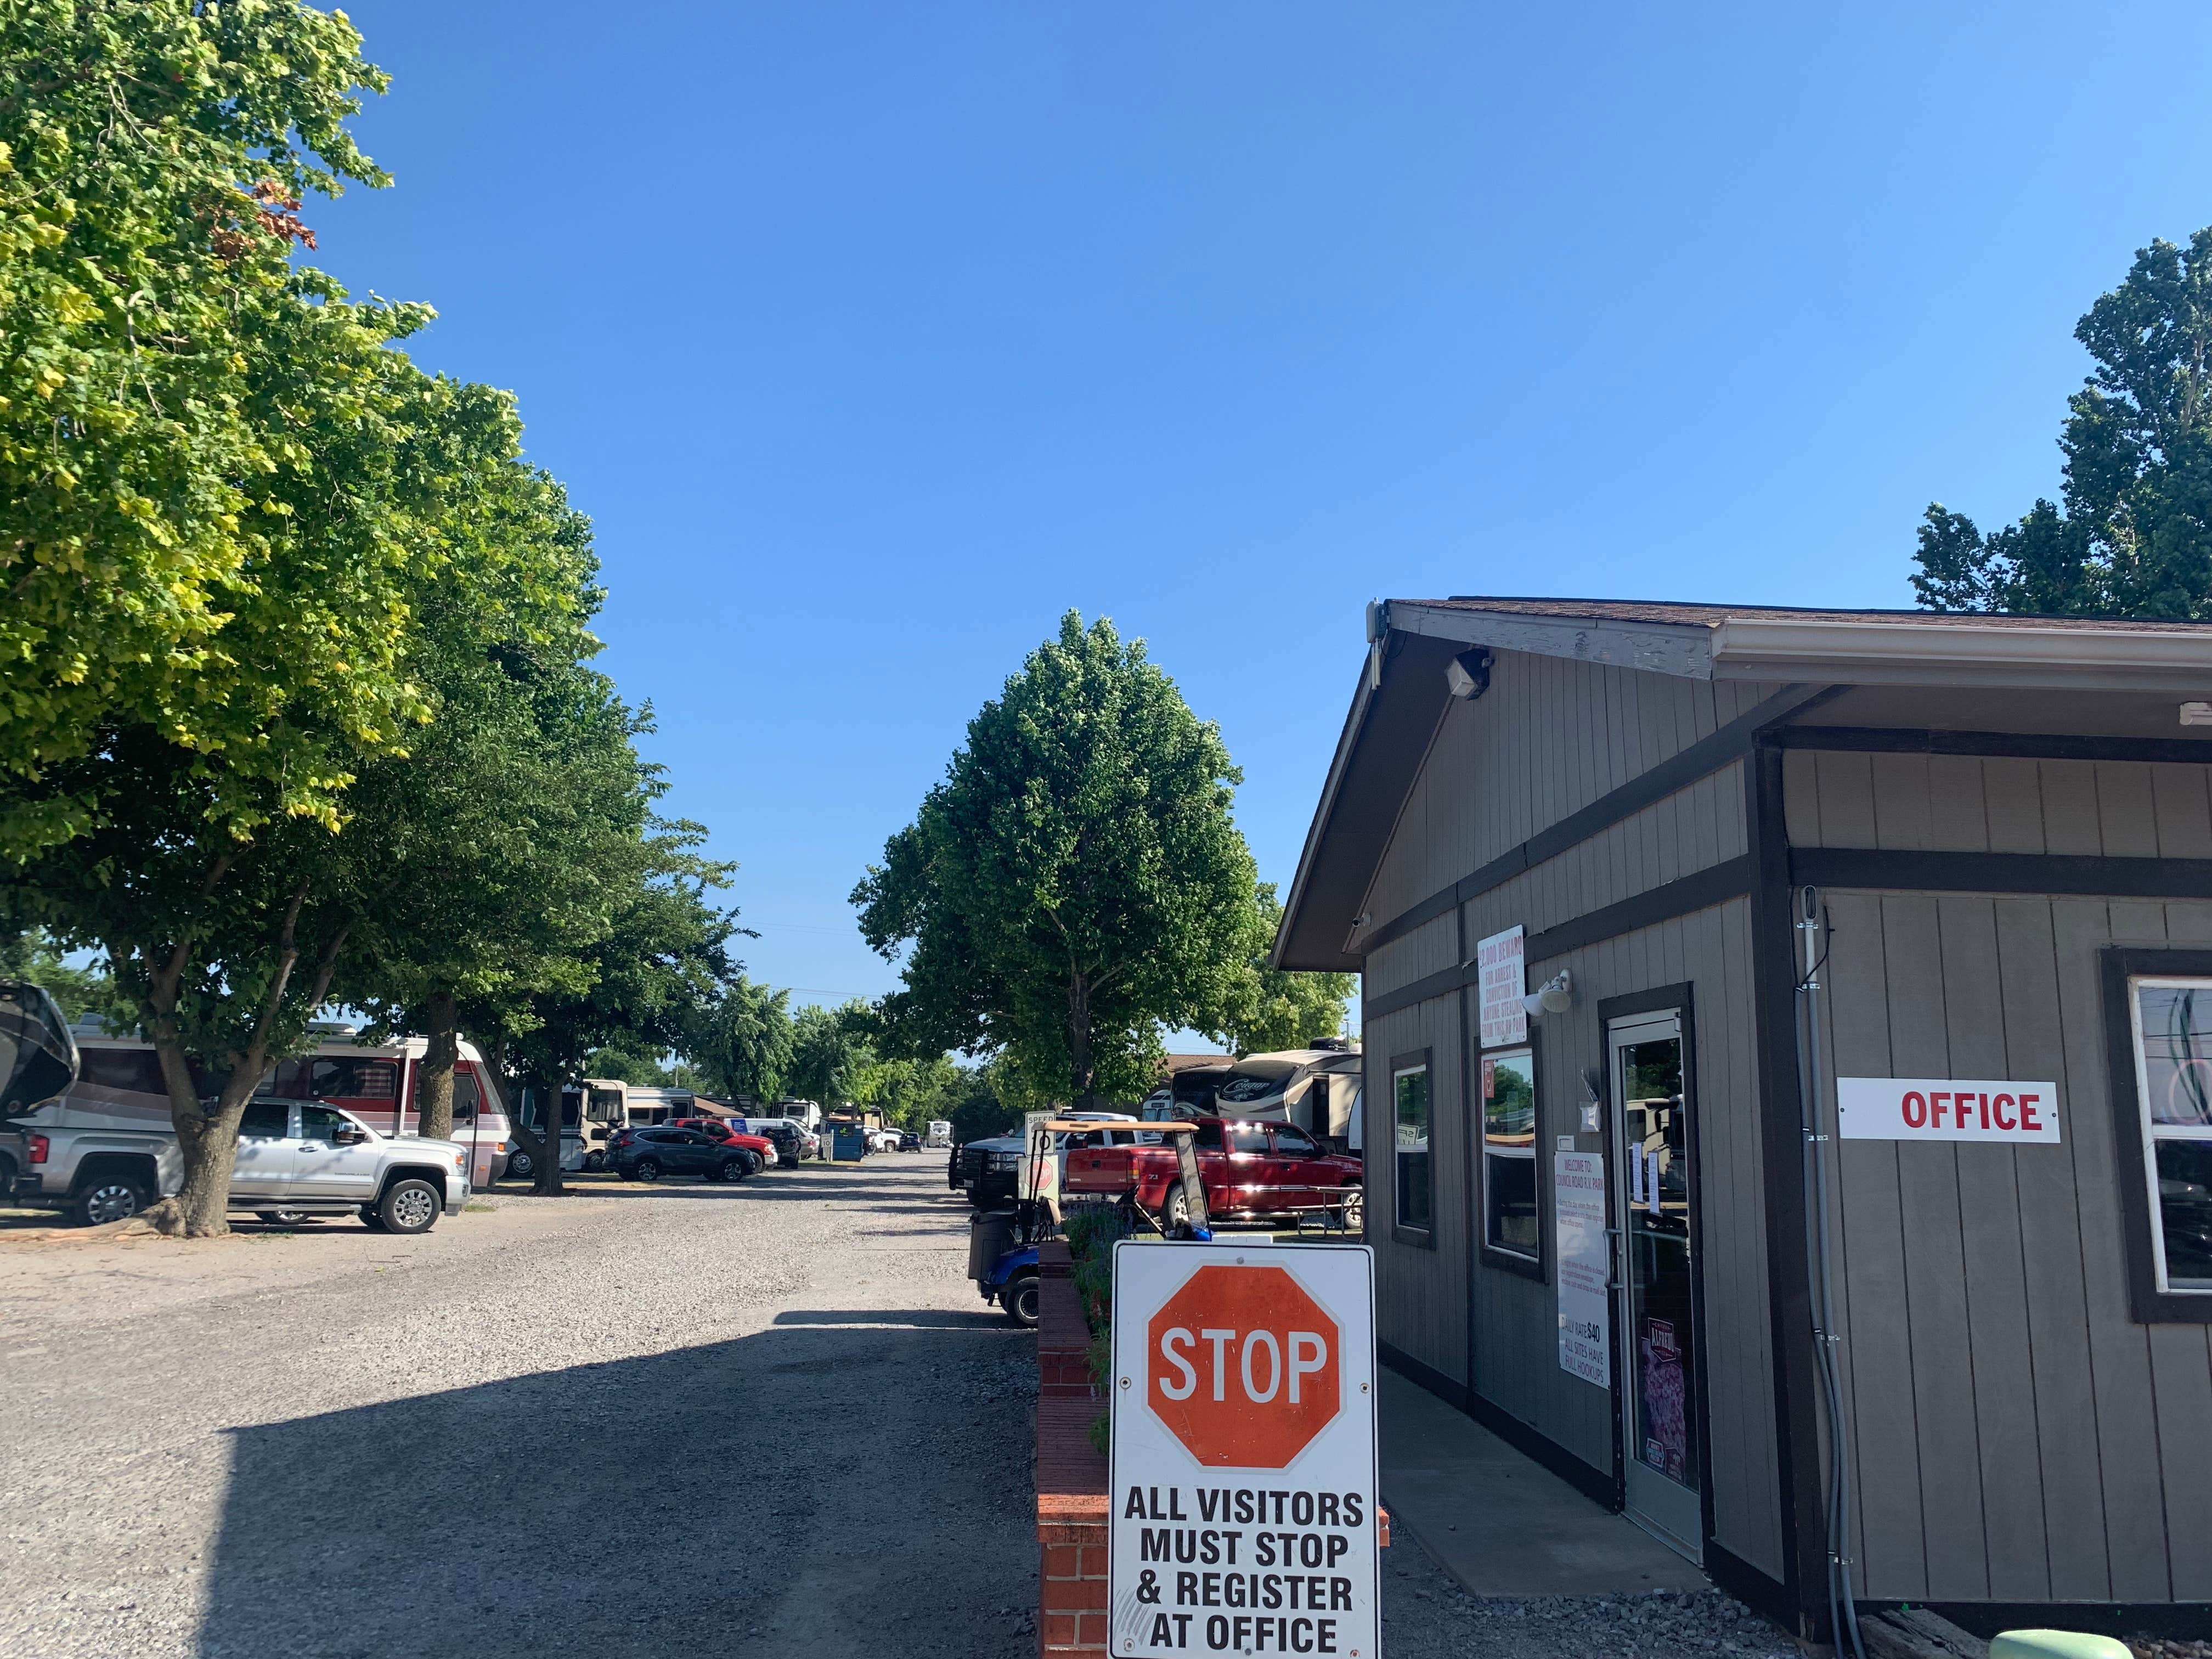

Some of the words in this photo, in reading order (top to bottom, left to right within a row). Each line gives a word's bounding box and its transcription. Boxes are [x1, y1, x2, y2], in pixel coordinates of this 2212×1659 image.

[1499, 935, 1522, 962] REWARD
[1496, 964, 1511, 983] ARREST
[1486, 983, 1511, 1003] CONVICTION
[1513, 981, 1517, 997] OF
[1483, 1003, 1500, 1021] ANYONE
[1501, 998, 1522, 1018] STEALING
[1482, 1023, 1493, 1039] FROM
[1494, 1020, 1505, 1036] THIS
[1513, 1015, 1526, 1034] PARK
[1222, 1079, 1270, 1096] Cougar
[1901, 1091, 2042, 1131] OFFICE
[1564, 1159, 1584, 1172] WELCOME
[1556, 1174, 1572, 1187] COUNCIL
[1572, 1176, 1584, 1189] ROAD
[1592, 1177, 1604, 1190] PARK
[1562, 1316, 1575, 1334] DAILY
[1565, 1338, 1573, 1353] ALL
[1575, 1342, 1588, 1358] SITES
[1589, 1347, 1603, 1365] HAVE
[1159, 1327, 1328, 1404] STOP
[1566, 1354, 1577, 1371] FULL
[1577, 1361, 1604, 1383] HOOKUPS
[1124, 1486, 1187, 1521] ALL
[1197, 1488, 1363, 1527] VISITORS
[1141, 1528, 1242, 1565] MUST
[1256, 1532, 1348, 1568] STOP
[1136, 1569, 1161, 1604] &
[1177, 1571, 1352, 1611] REGISTER
[1150, 1613, 1193, 1648] AT
[1207, 1615, 1336, 1654] OFFICE
